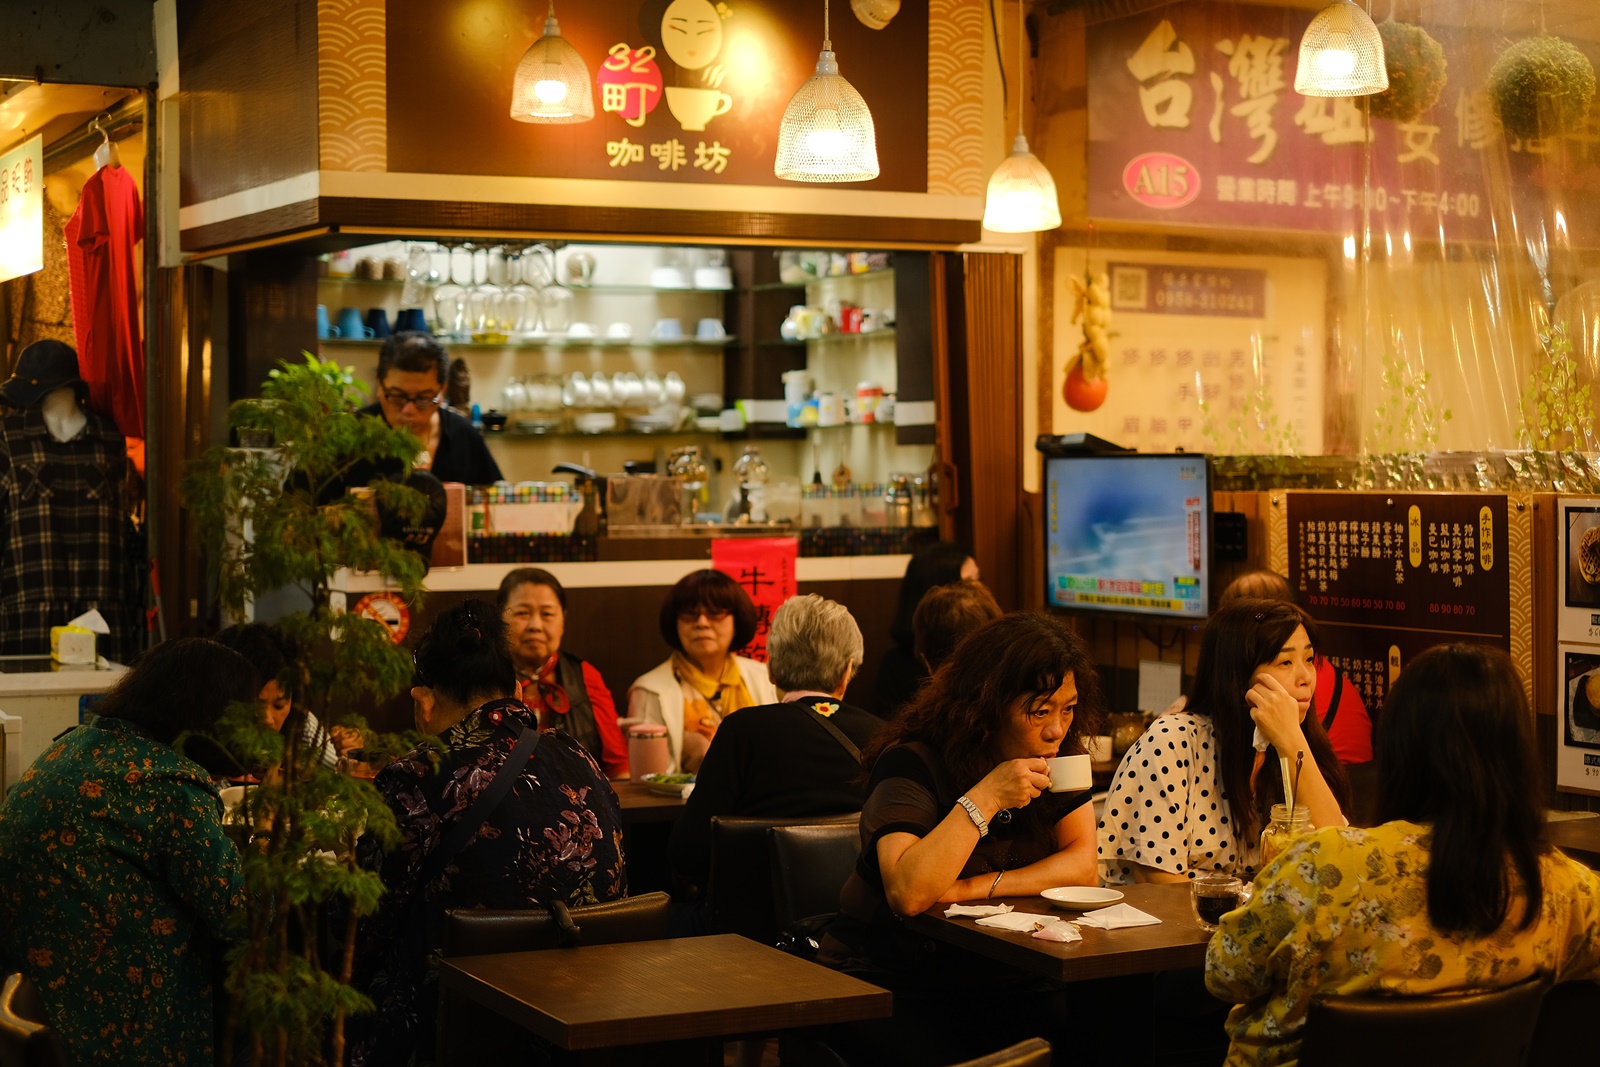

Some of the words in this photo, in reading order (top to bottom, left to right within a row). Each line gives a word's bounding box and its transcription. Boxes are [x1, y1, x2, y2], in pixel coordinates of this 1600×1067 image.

[604, 43, 656, 73] 32
[602, 82, 657, 127] 町
[606, 137, 731, 174] 咖啡坊
[1134, 163, 1188, 197] A15
[1410, 516, 1420, 554] 冰品
[1481, 513, 1492, 565] 手作咖啡
